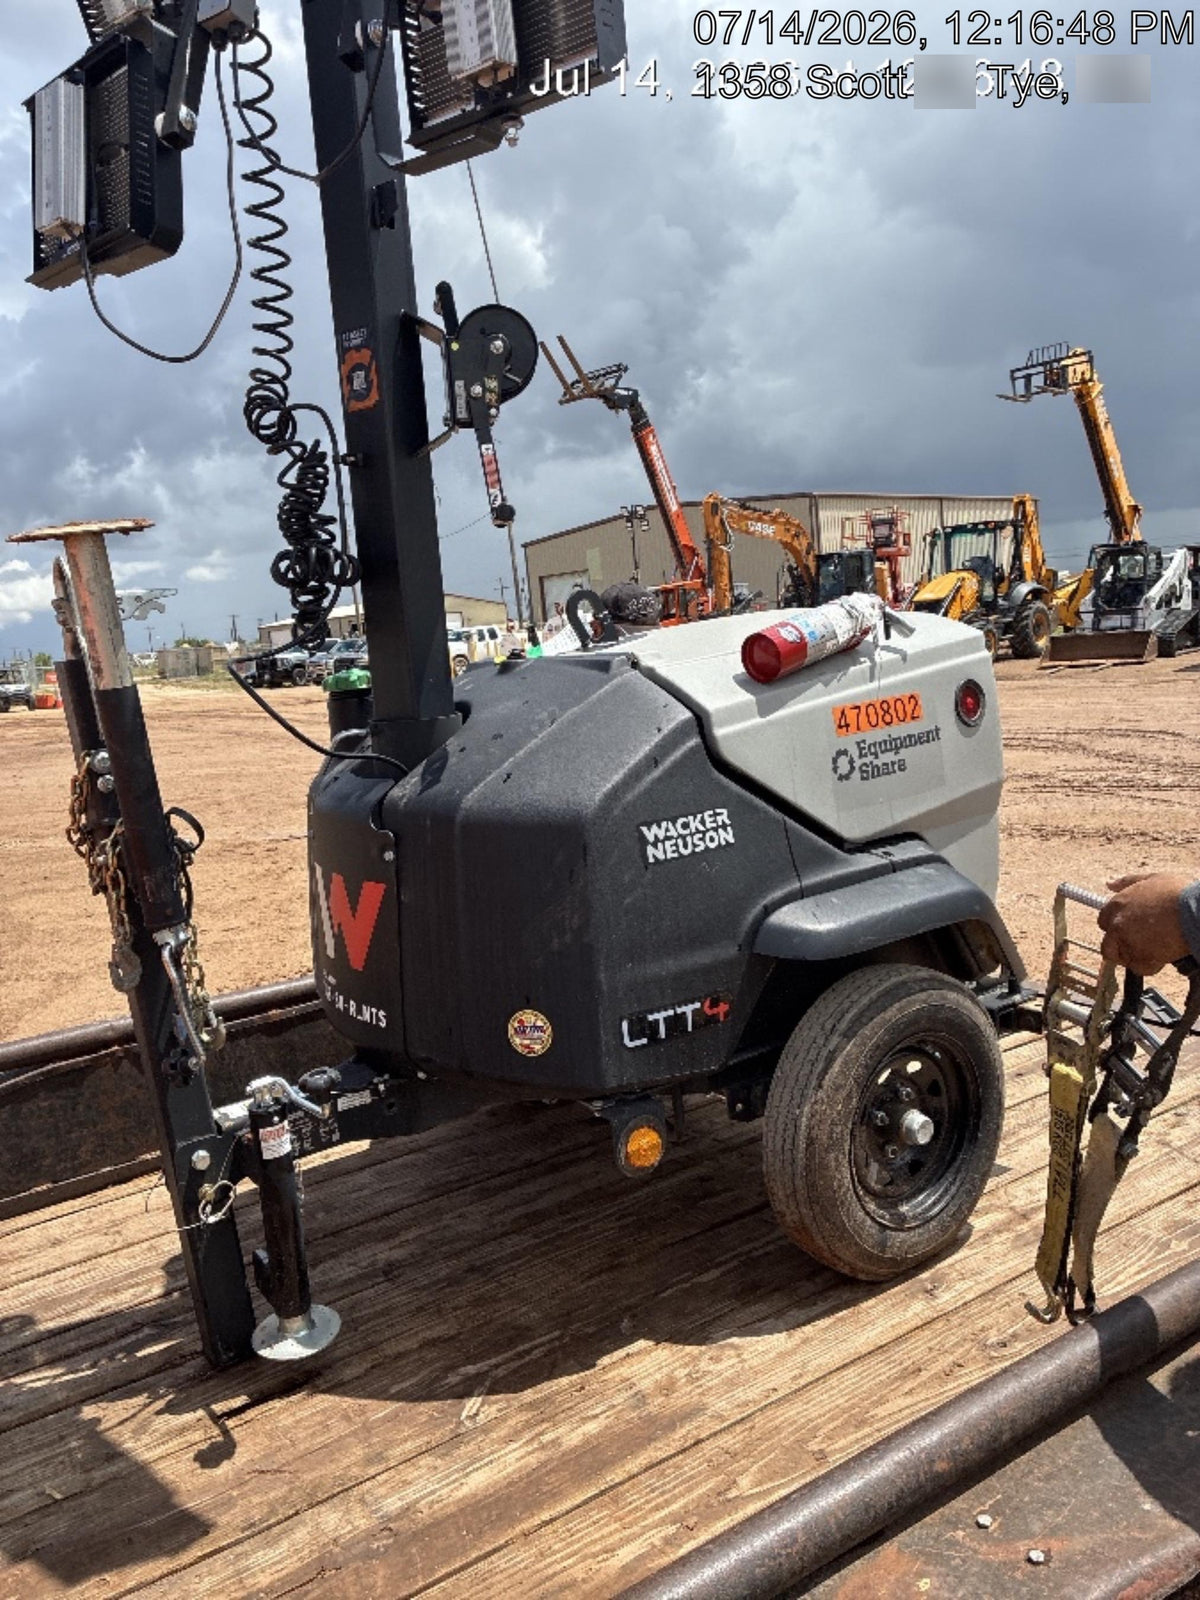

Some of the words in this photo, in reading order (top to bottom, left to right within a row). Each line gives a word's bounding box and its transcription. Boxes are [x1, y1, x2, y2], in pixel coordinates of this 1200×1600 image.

[836, 694, 922, 734] 470802
[855, 725, 942, 761] Equipment
[859, 756, 908, 783] Share
[640, 808, 732, 842] WACKER
[645, 826, 736, 863] NEUSON
